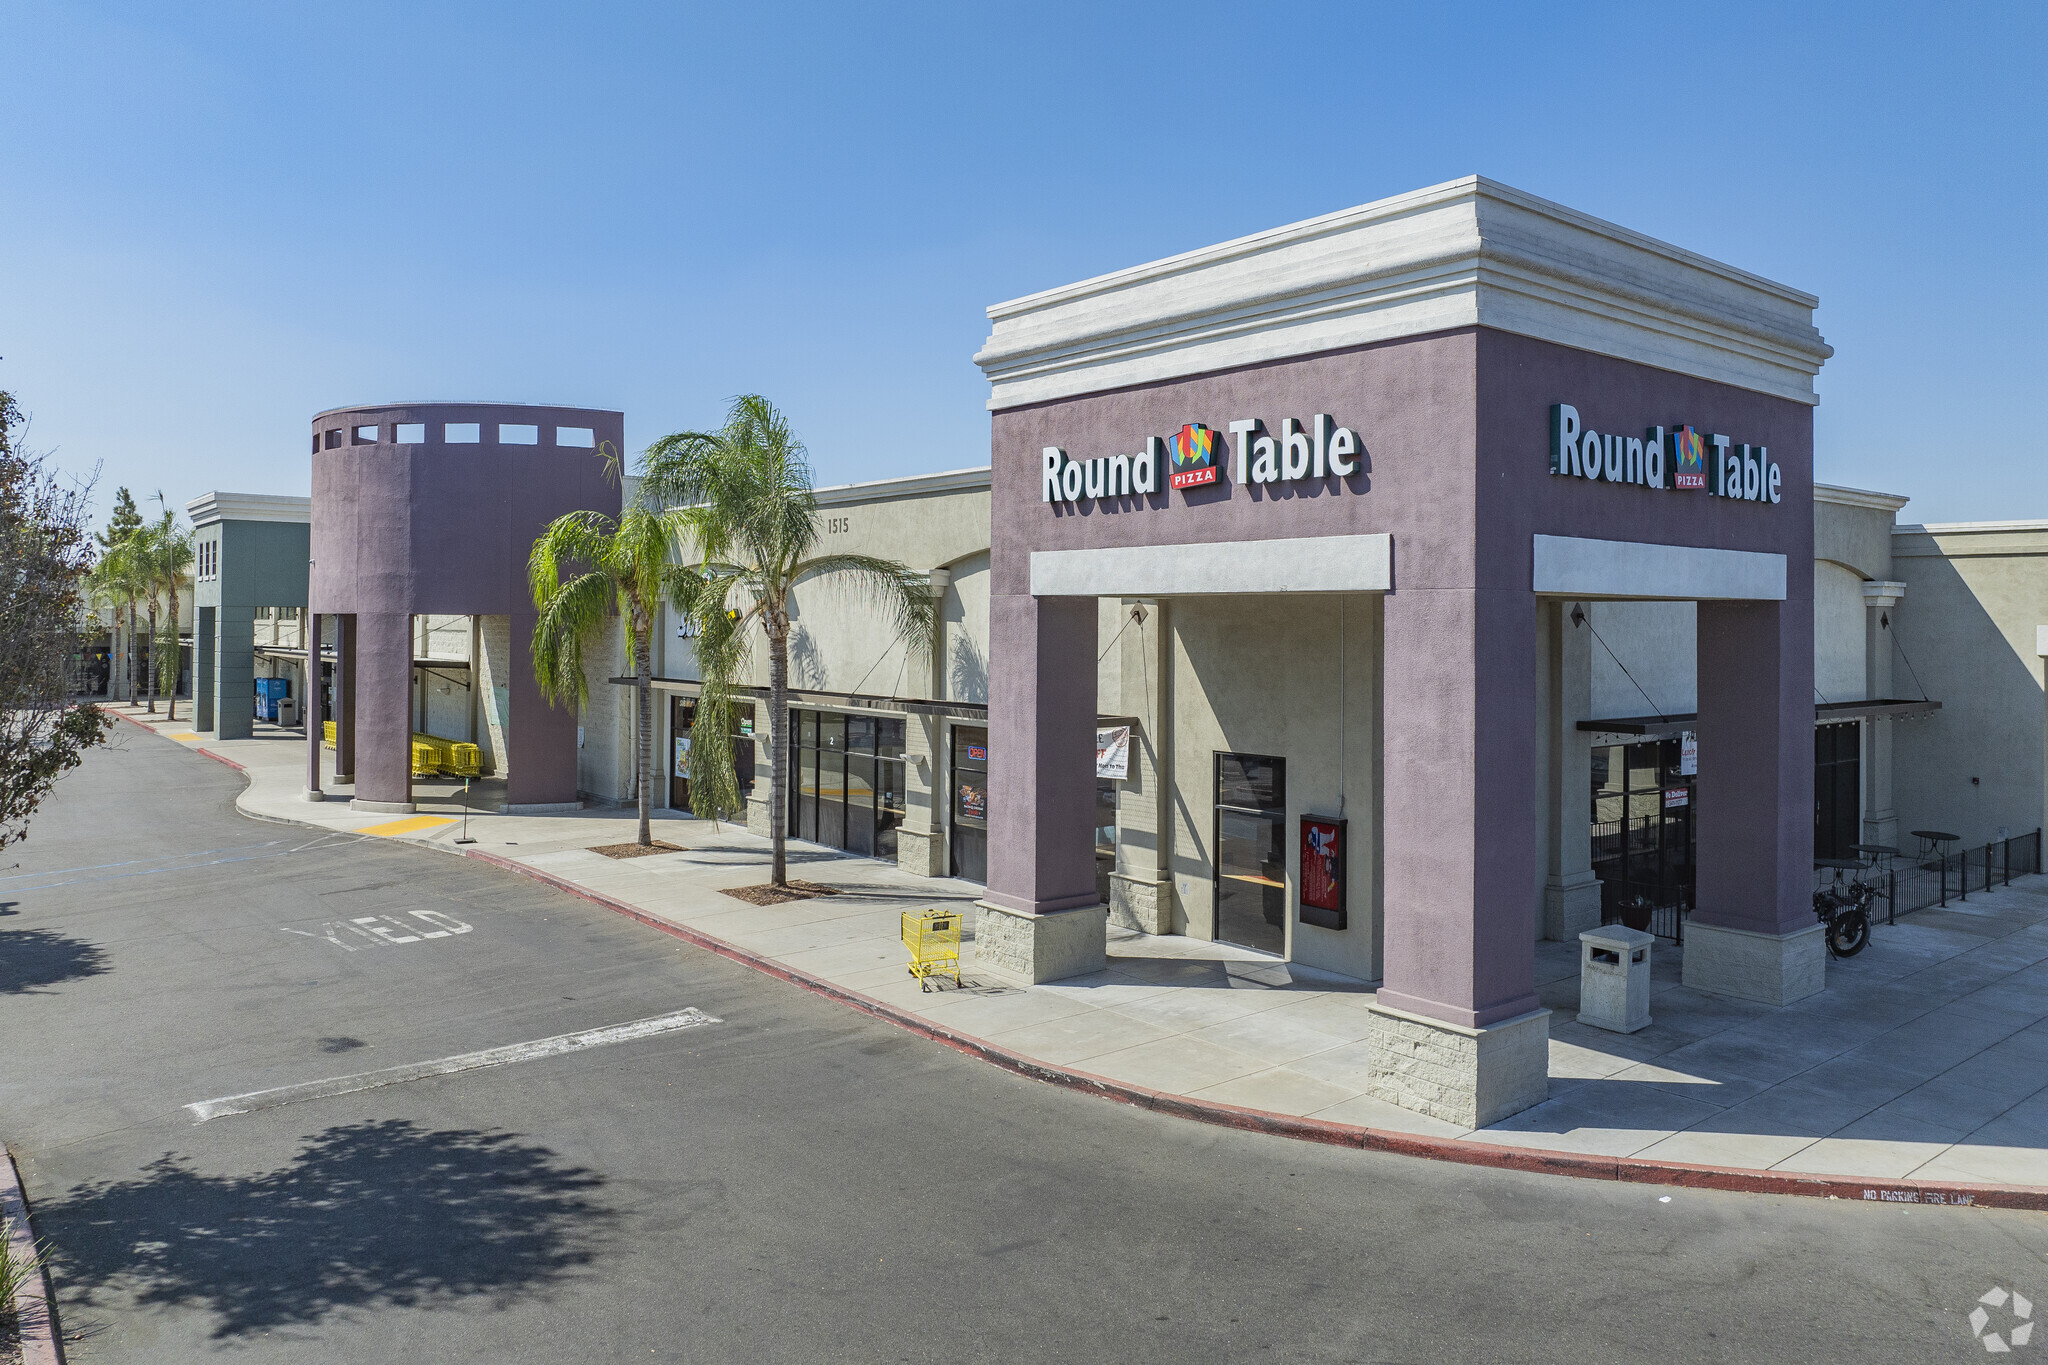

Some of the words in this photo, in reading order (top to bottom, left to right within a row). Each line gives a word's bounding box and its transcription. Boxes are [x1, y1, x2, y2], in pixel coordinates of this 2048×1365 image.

[1042, 435, 1160, 503] Round
[1229, 413, 1360, 486] Table
[1555, 403, 1664, 490] Round
[1711, 433, 1781, 504] Table
[1174, 469, 1214, 486] PIZZA
[1677, 475, 1704, 487] PIZZA
[828, 517, 849, 534] 1515
[969, 748, 985, 759] OPEN
[1671, 790, 1688, 798] Deliver
[279, 909, 474, 951] YIELD
[1863, 1189, 1877, 1201] NO
[1880, 1190, 1919, 1203] PARKING
[1924, 1192, 1947, 1204] FIRE
[1950, 1193, 1976, 1205] LANE
